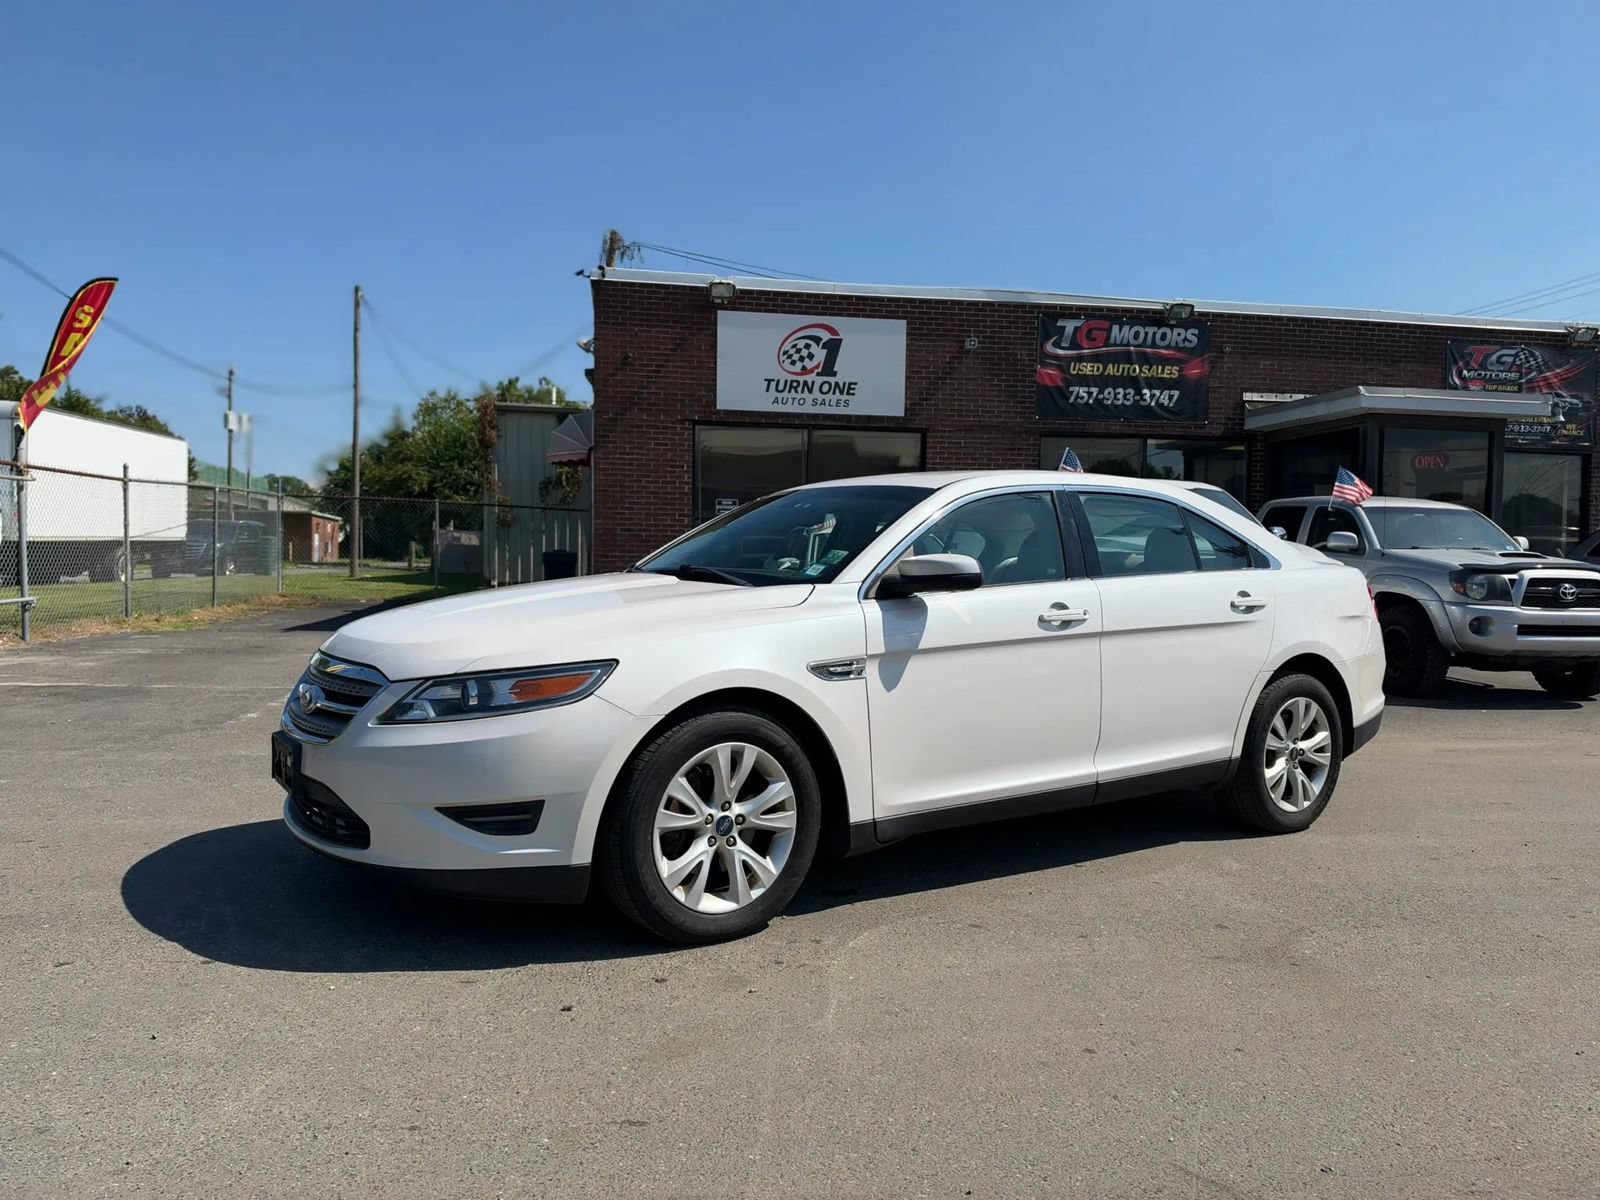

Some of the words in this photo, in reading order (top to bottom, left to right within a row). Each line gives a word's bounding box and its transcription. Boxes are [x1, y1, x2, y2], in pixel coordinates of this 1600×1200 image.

[1056, 318, 1111, 348] TG
[1109, 324, 1199, 348] MOTORS
[1468, 346, 1518, 371] TG
[1069, 362, 1103, 375] USED
[1104, 363, 1140, 377] AUTO
[1140, 364, 1180, 378] SALES
[1461, 369, 1520, 380] MOTORS
[763, 378, 815, 394] TURN
[818, 380, 858, 396] ONE
[771, 396, 806, 406] AUTO
[811, 398, 850, 408] SALES
[1068, 386, 1180, 407] 757-933-3747
[1504, 424, 1551, 433] 7-933-3747
[1415, 455, 1445, 468] OPEN
